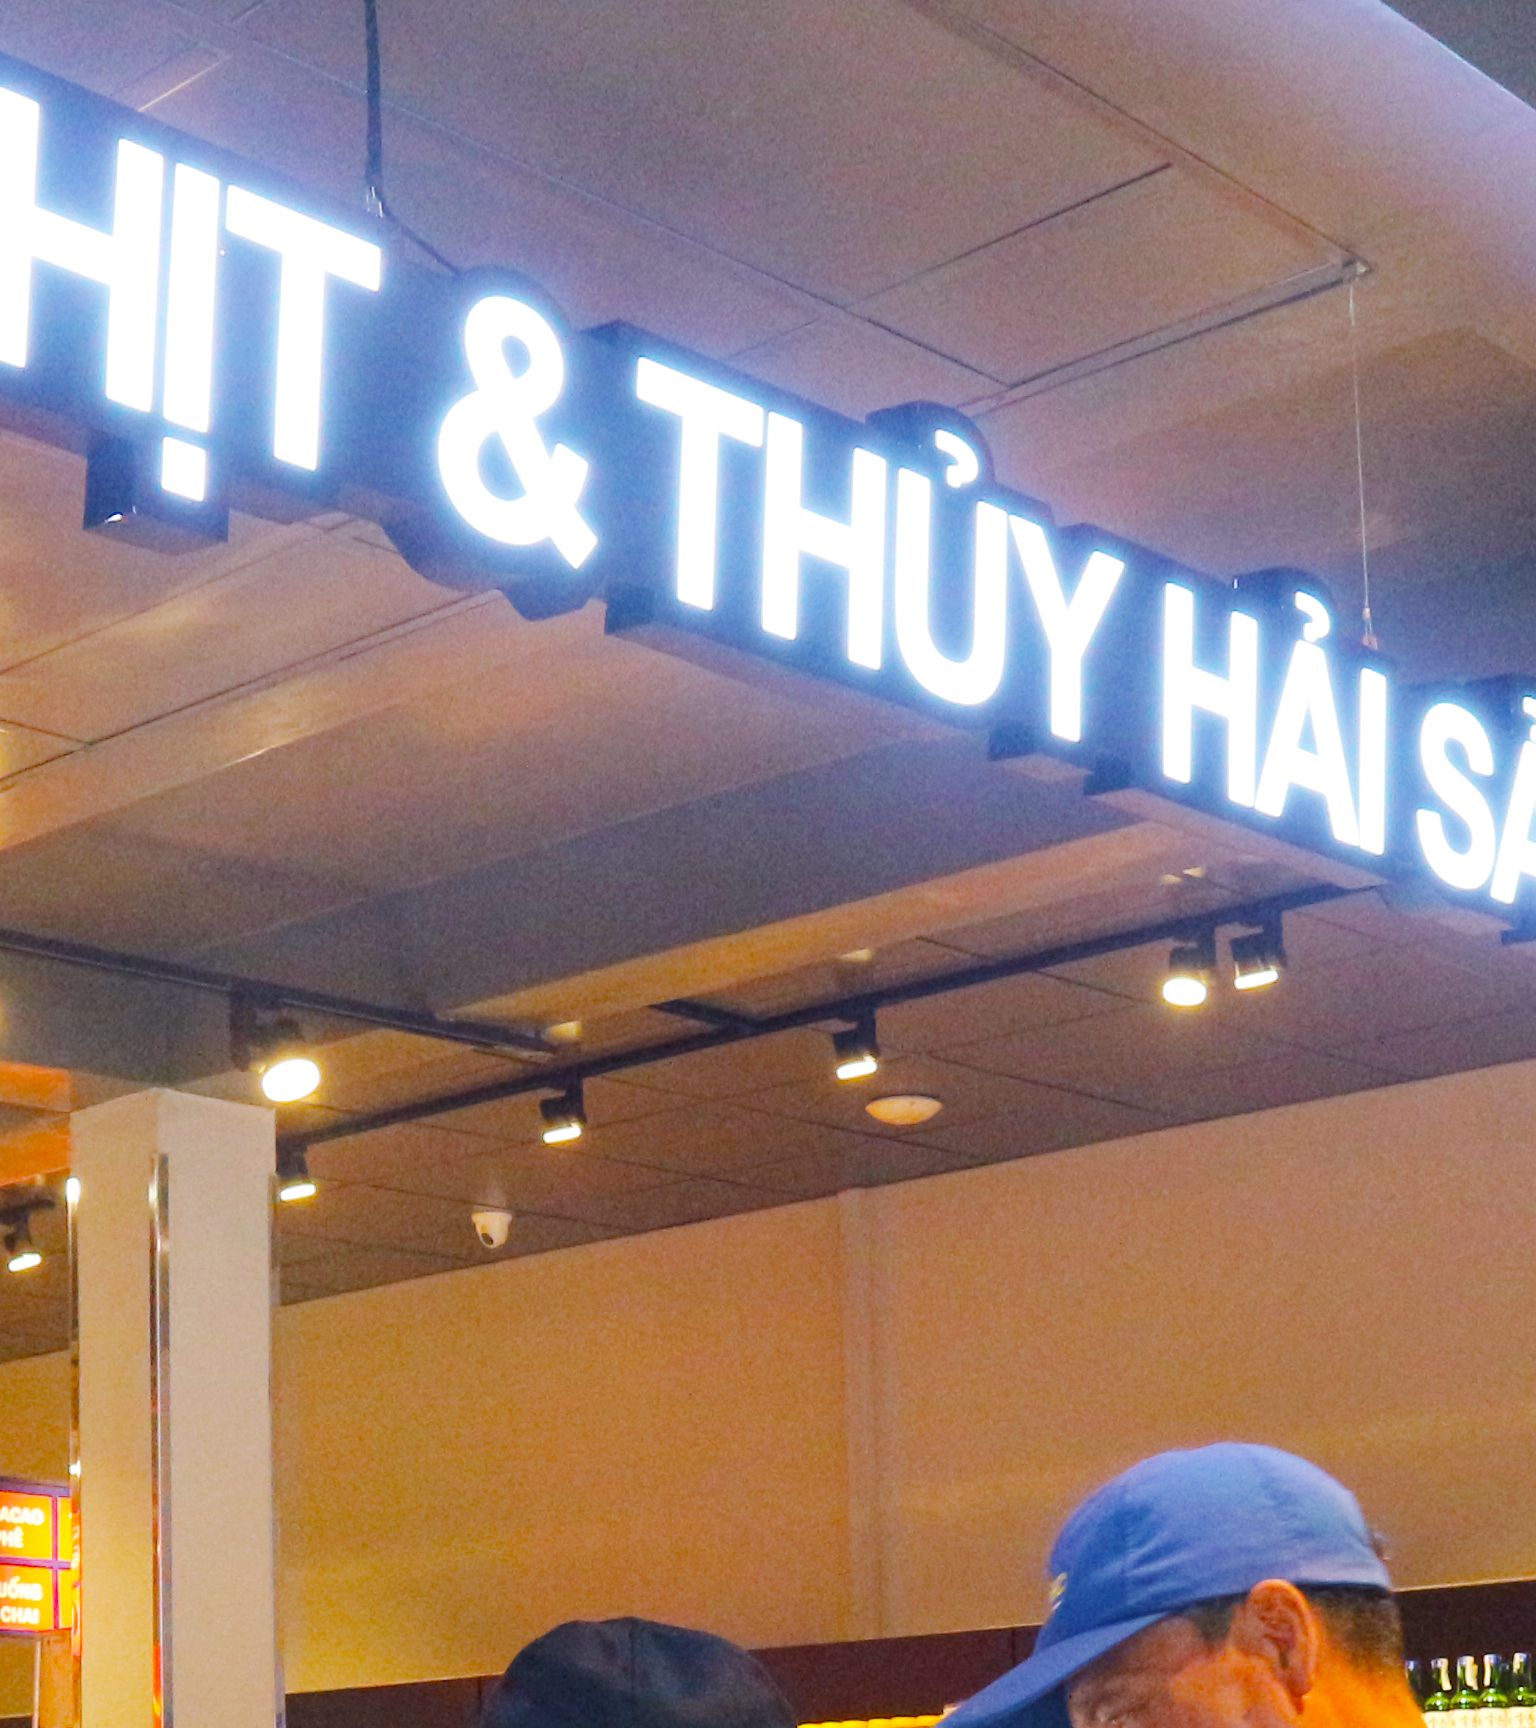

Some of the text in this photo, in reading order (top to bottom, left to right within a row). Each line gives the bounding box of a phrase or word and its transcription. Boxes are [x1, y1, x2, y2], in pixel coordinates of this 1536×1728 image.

[437, 294, 598, 570] &
[636, 356, 1124, 742] THỦY
[1161, 583, 1388, 857] HẢI
[0, 1604, 41, 1626] CHAI
